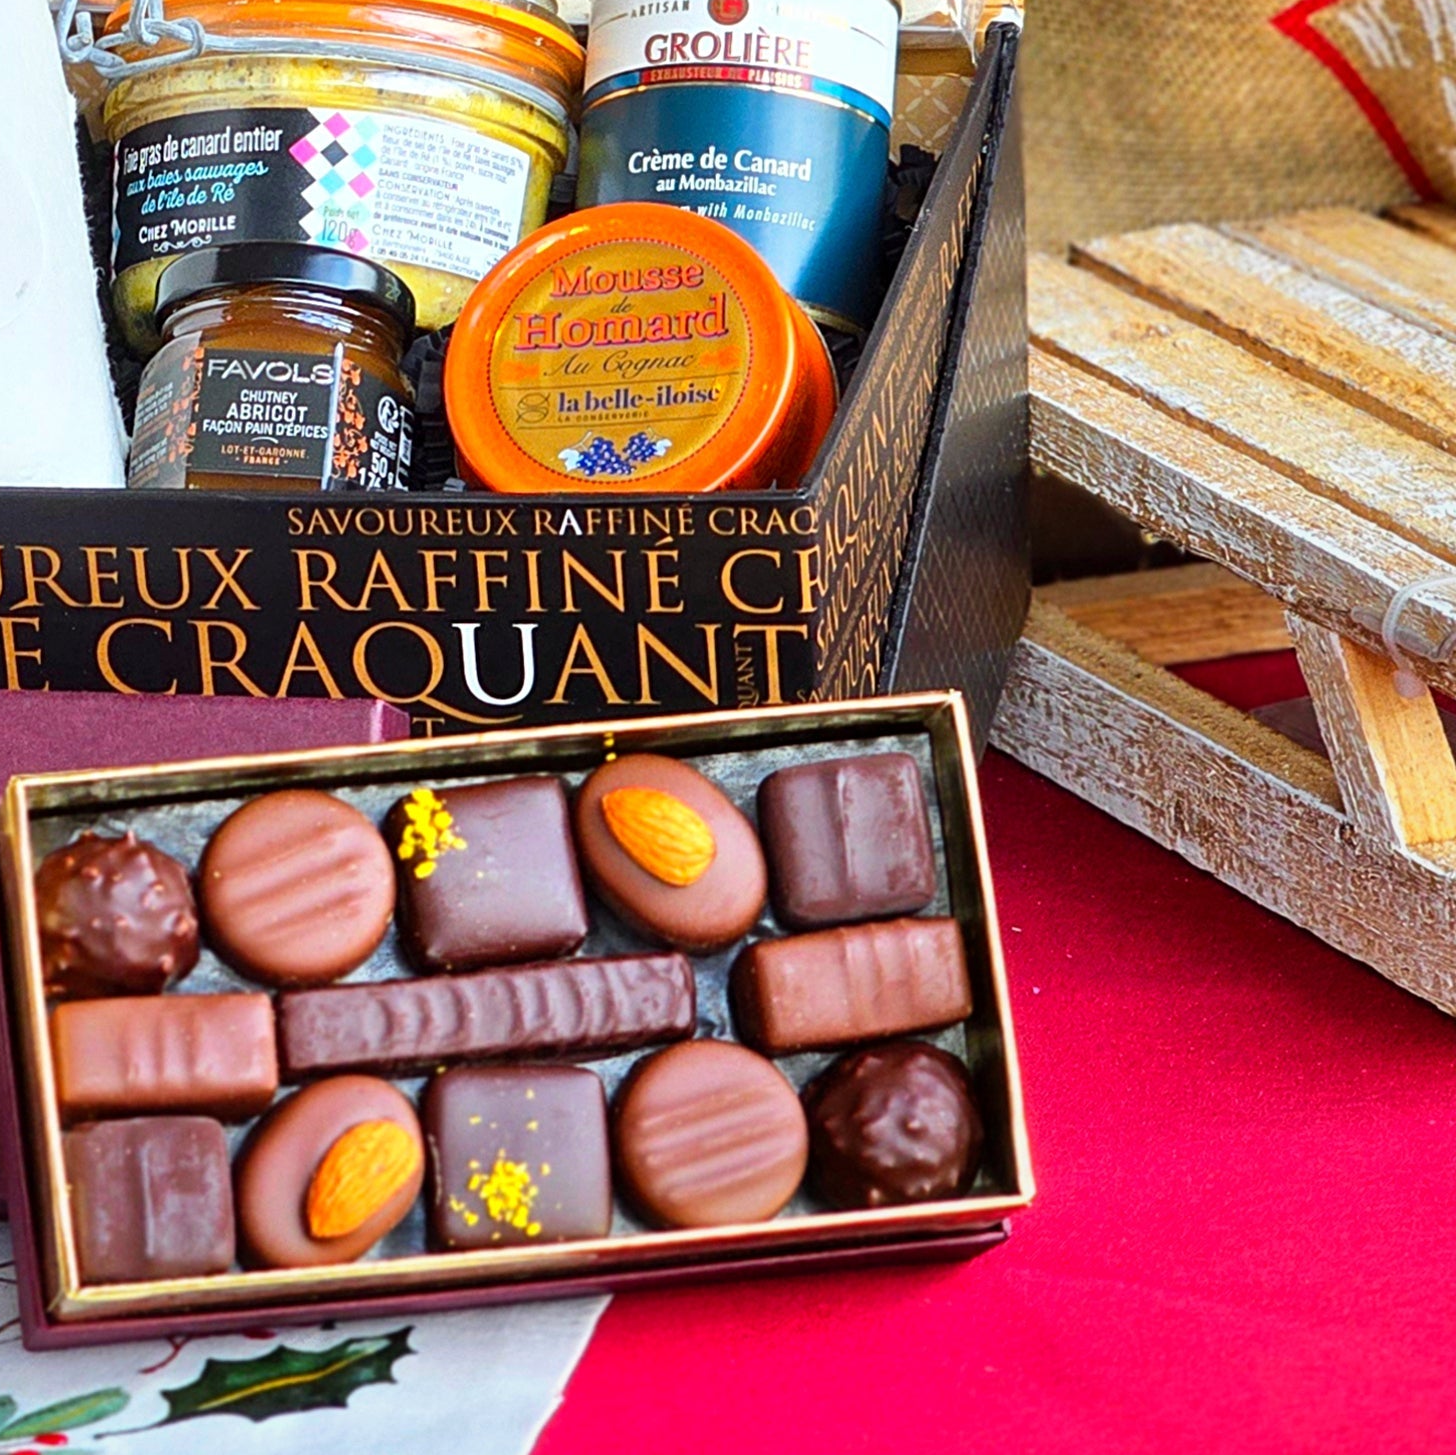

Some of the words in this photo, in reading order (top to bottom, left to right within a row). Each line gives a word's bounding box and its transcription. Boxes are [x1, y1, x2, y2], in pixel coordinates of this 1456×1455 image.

[630, 0, 690, 20] ARTISAN
[644, 26, 811, 70] GROLIÈRE
[139, 141, 162, 175] gras
[162, 133, 180, 161] de
[180, 126, 232, 159] canard
[233, 126, 284, 153] entier
[628, 149, 694, 174] Crème
[700, 145, 728, 171] de
[733, 149, 812, 182] Canard
[126, 178, 146, 197] aux
[146, 166, 183, 189] baies
[184, 160, 270, 185] sauvages
[655, 178, 676, 193] au
[678, 174, 776, 197] Monbazillac
[141, 196, 157, 215] de
[186, 186, 208, 206] de
[210, 182, 236, 205] Ré
[138, 222, 168, 245] CHEZ
[170, 214, 237, 238] MORILLE
[696, 201, 728, 219] with
[733, 203, 816, 232] Monbazillac
[550, 262, 705, 298] Mousse
[610, 295, 636, 315] de
[513, 292, 730, 352] Homard
[206, 358, 335, 386] FAVOLS
[544, 353, 593, 377] Au
[601, 350, 695, 380] Cognac
[240, 389, 298, 403] CHUTNEY
[557, 392, 581, 413] la
[584, 383, 721, 412] belle-iloise
[225, 402, 309, 424] ABRICOT
[202, 418, 243, 437] FAÇON
[244, 420, 274, 435] PAIN
[275, 420, 330, 440] D'ÉPICES
[287, 507, 520, 537] SAVOUREUX
[533, 503, 696, 537] RAFFINÉ
[290, 536, 685, 614] RAFFINÉ
[95, 617, 809, 725] CRAQUANT
